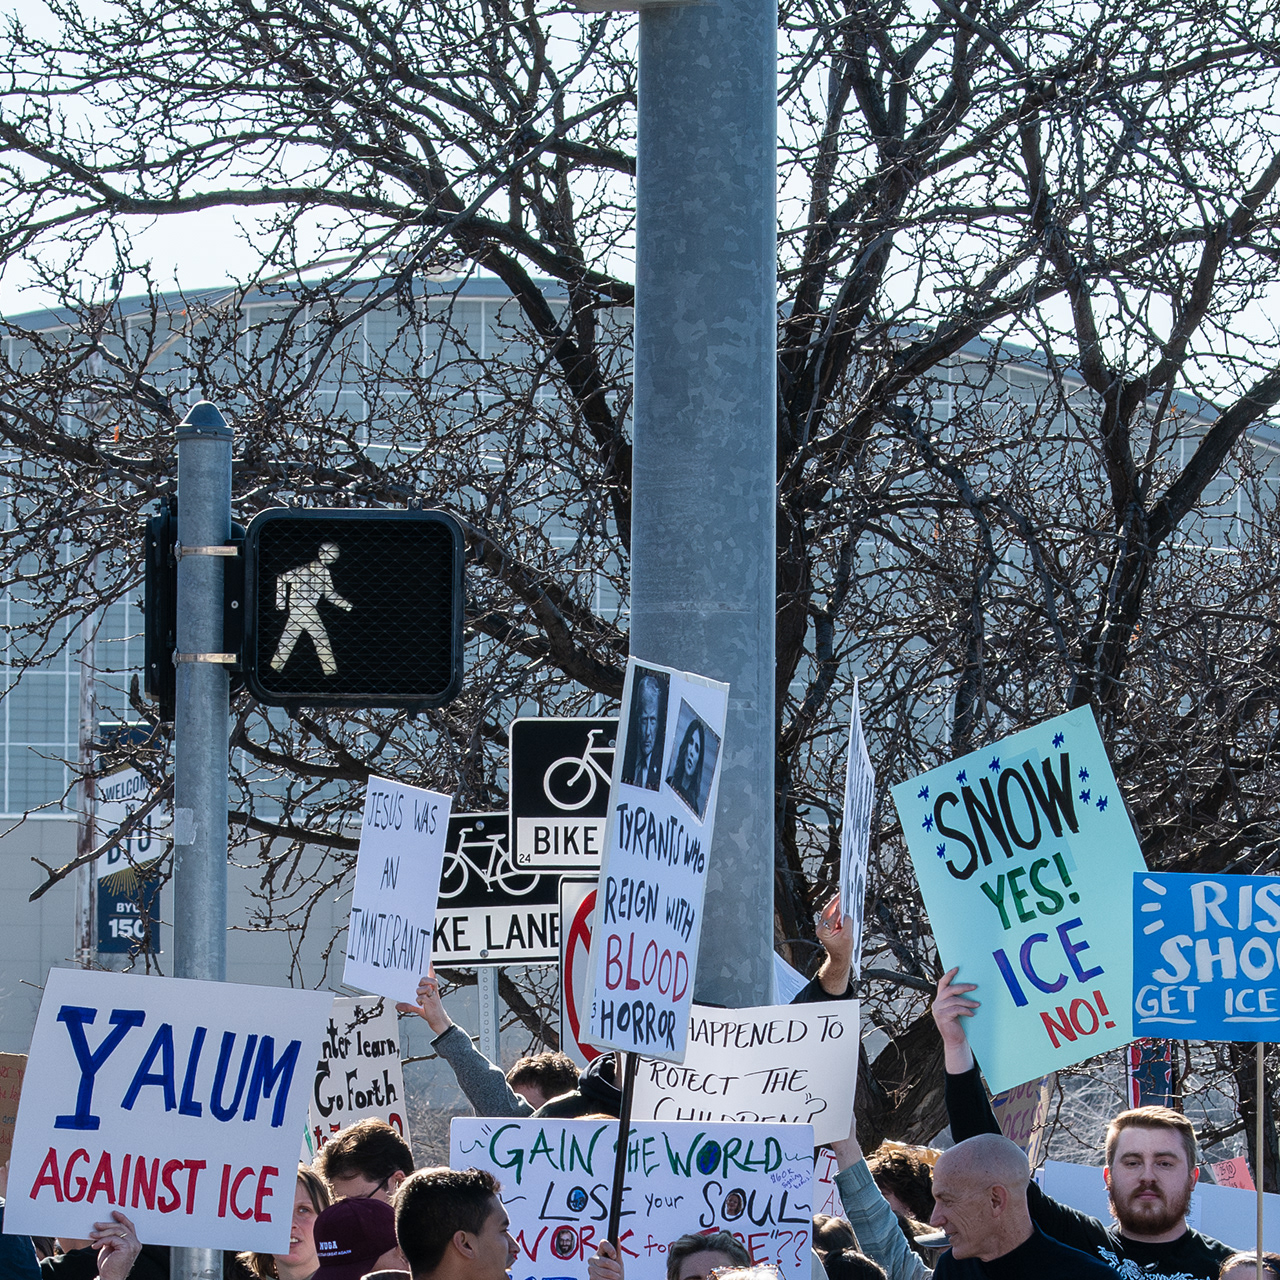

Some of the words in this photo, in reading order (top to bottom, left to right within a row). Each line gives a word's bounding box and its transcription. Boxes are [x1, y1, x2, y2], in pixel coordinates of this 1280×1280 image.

[106, 774, 150, 801] WELCOM
[367, 790, 404, 831] JESUS
[413, 799, 438, 835] WAS
[933, 751, 1081, 880] SNOW
[519, 853, 531, 864] 24
[534, 826, 599, 856] BIKE
[616, 803, 685, 867] TYRANTS
[683, 832, 706, 875] WHO
[380, 856, 401, 890] AN
[981, 852, 1081, 932] YES!
[108, 918, 147, 940] 150
[116, 902, 141, 914] BYU
[604, 875, 660, 925] REIGN
[666, 894, 696, 943] WITH
[347, 907, 431, 975] IMMIGRANT
[433, 915, 471, 953] KE
[605, 932, 690, 1003] BLOOD
[993, 917, 1106, 1008] ICE
[1040, 990, 1116, 1050] NO!
[1136, 984, 1198, 1018] GET
[1224, 987, 1279, 1015] ICE
[322, 1018, 353, 1060] nter
[356, 1031, 401, 1059] learn,
[601, 999, 676, 1052] HORROR
[817, 1014, 844, 1043] TO
[53, 1005, 302, 1131] YALUM
[314, 1060, 344, 1118] Go
[345, 1067, 399, 1111] Forth
[744, 1066, 809, 1095] THE
[662, 1131, 784, 1179] WORLD
[28, 1147, 207, 1216] AGAINST
[217, 1163, 279, 1223] ICE
[699, 1180, 812, 1229] SOUL
